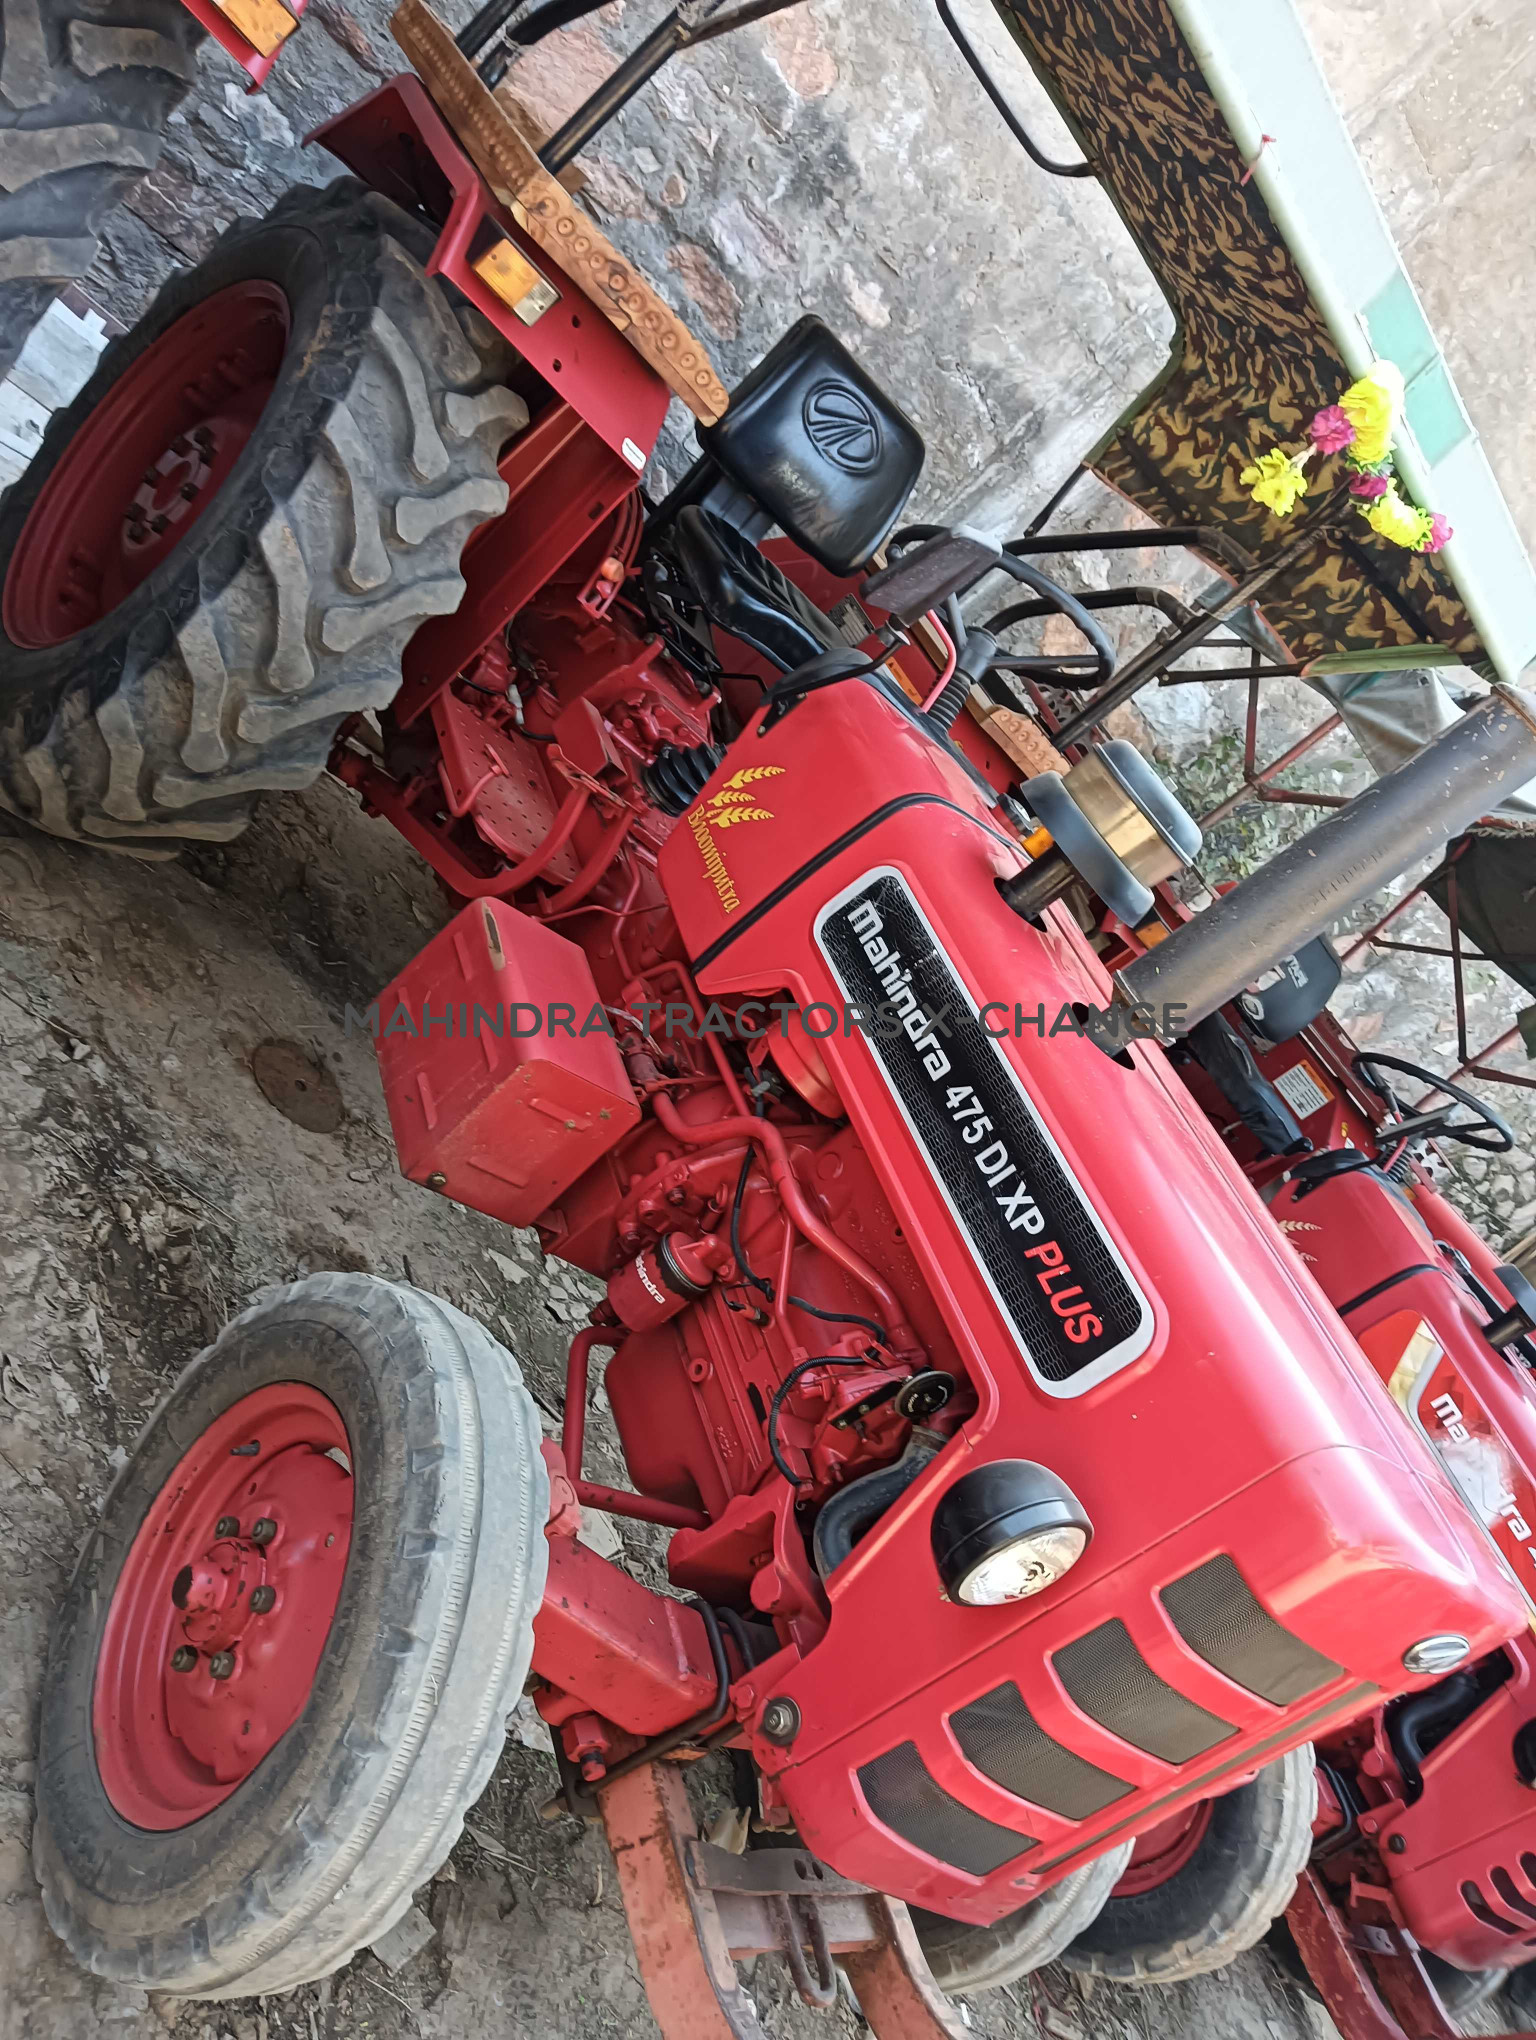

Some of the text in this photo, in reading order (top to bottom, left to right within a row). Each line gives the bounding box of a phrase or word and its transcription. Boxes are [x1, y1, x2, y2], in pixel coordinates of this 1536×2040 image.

[945, 1084, 994, 1144] 475
[974, 1139, 1017, 1188] DI
[995, 1180, 1045, 1235] XP
[1023, 1240, 1103, 1344] PLUS
